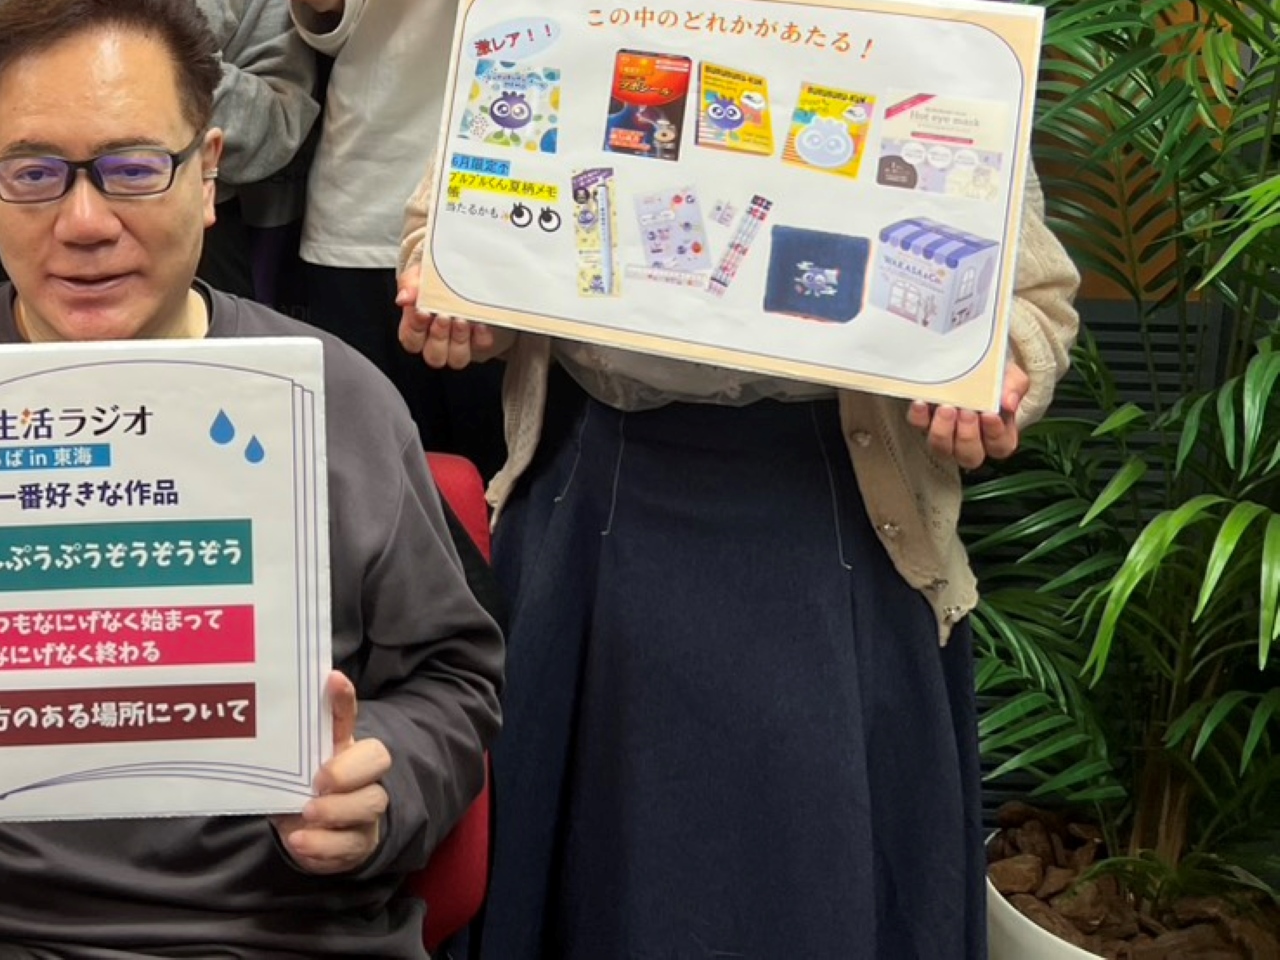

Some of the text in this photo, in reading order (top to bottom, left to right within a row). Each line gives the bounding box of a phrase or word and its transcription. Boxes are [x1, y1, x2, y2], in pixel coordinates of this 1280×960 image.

[587, 6, 874, 59] この中のどれかがあたる！
[52, 447, 93, 467] 東海
